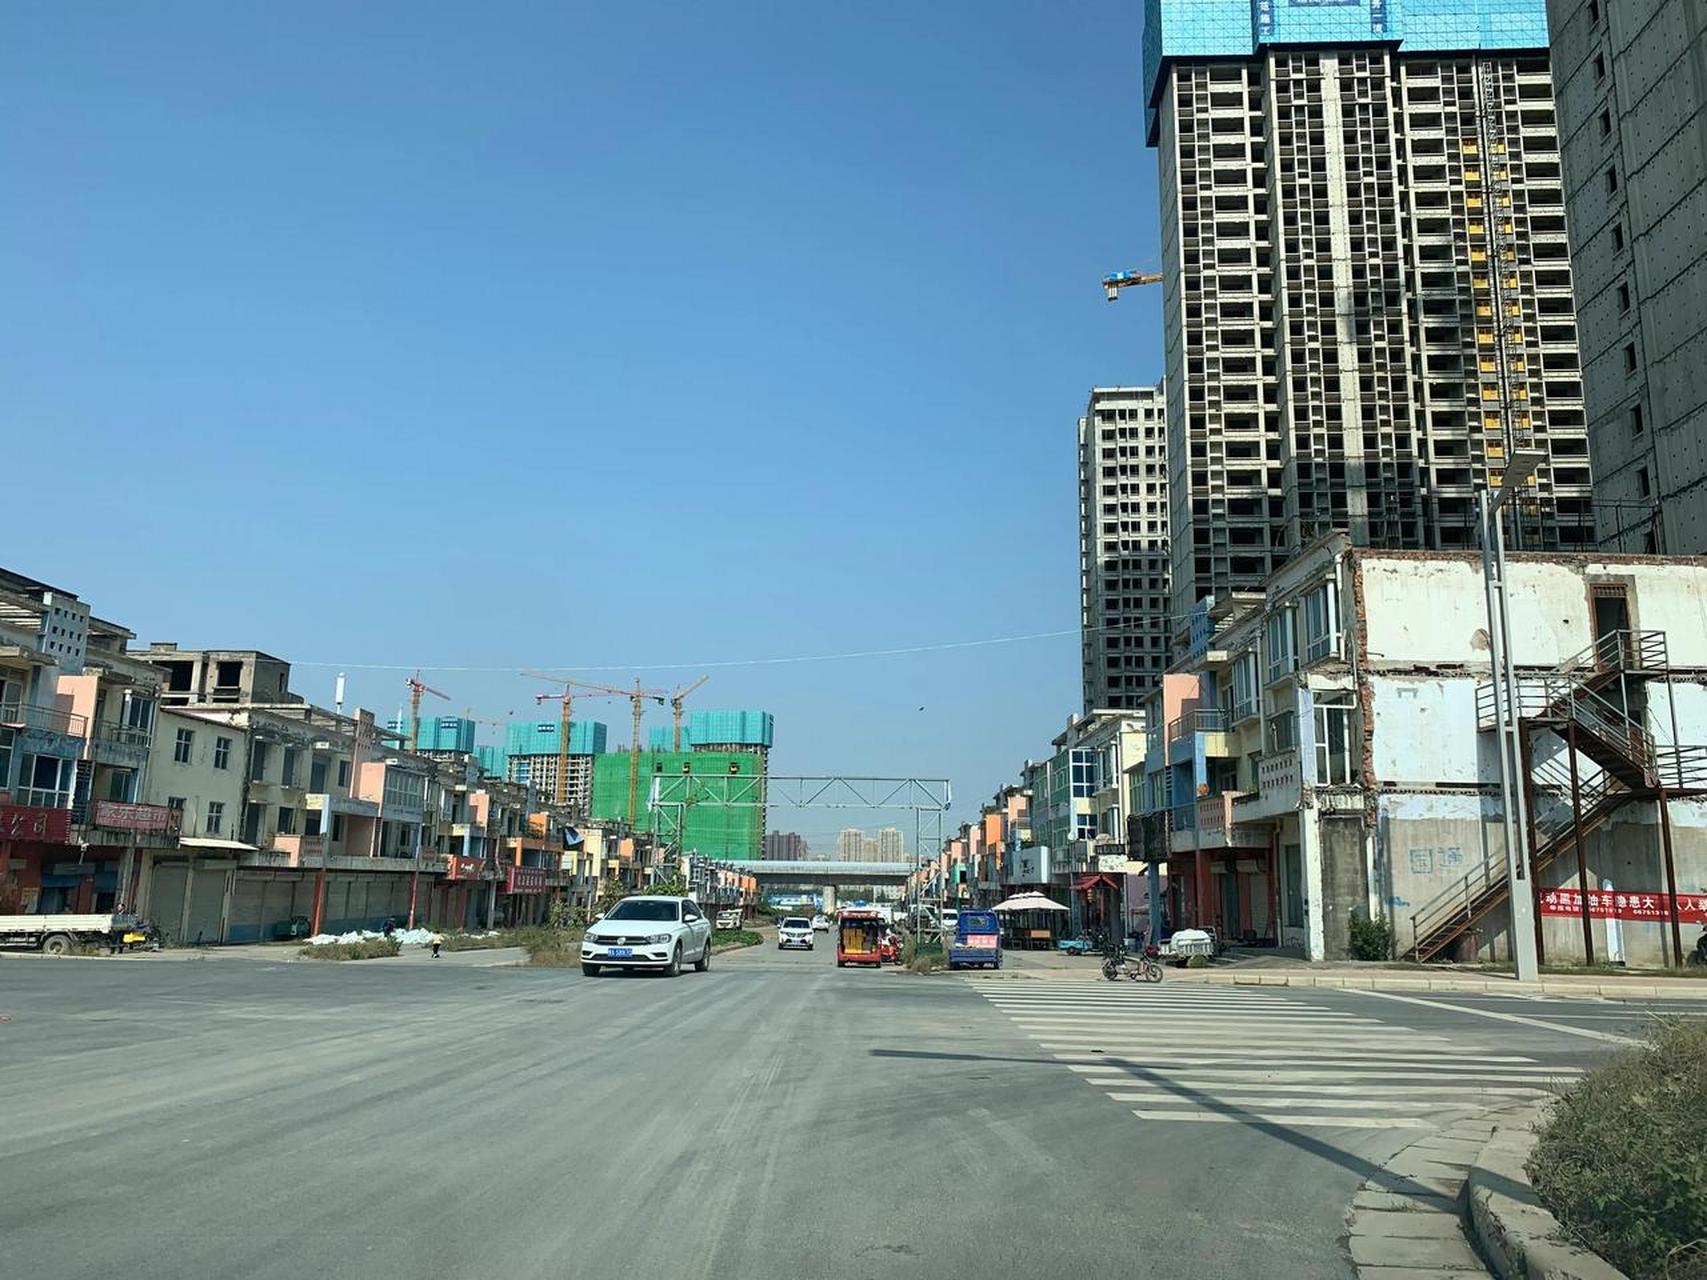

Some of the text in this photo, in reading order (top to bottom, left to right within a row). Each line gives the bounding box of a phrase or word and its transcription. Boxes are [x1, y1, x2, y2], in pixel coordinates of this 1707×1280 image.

[1540, 892, 1654, 909] 动黑加油车隐患大
